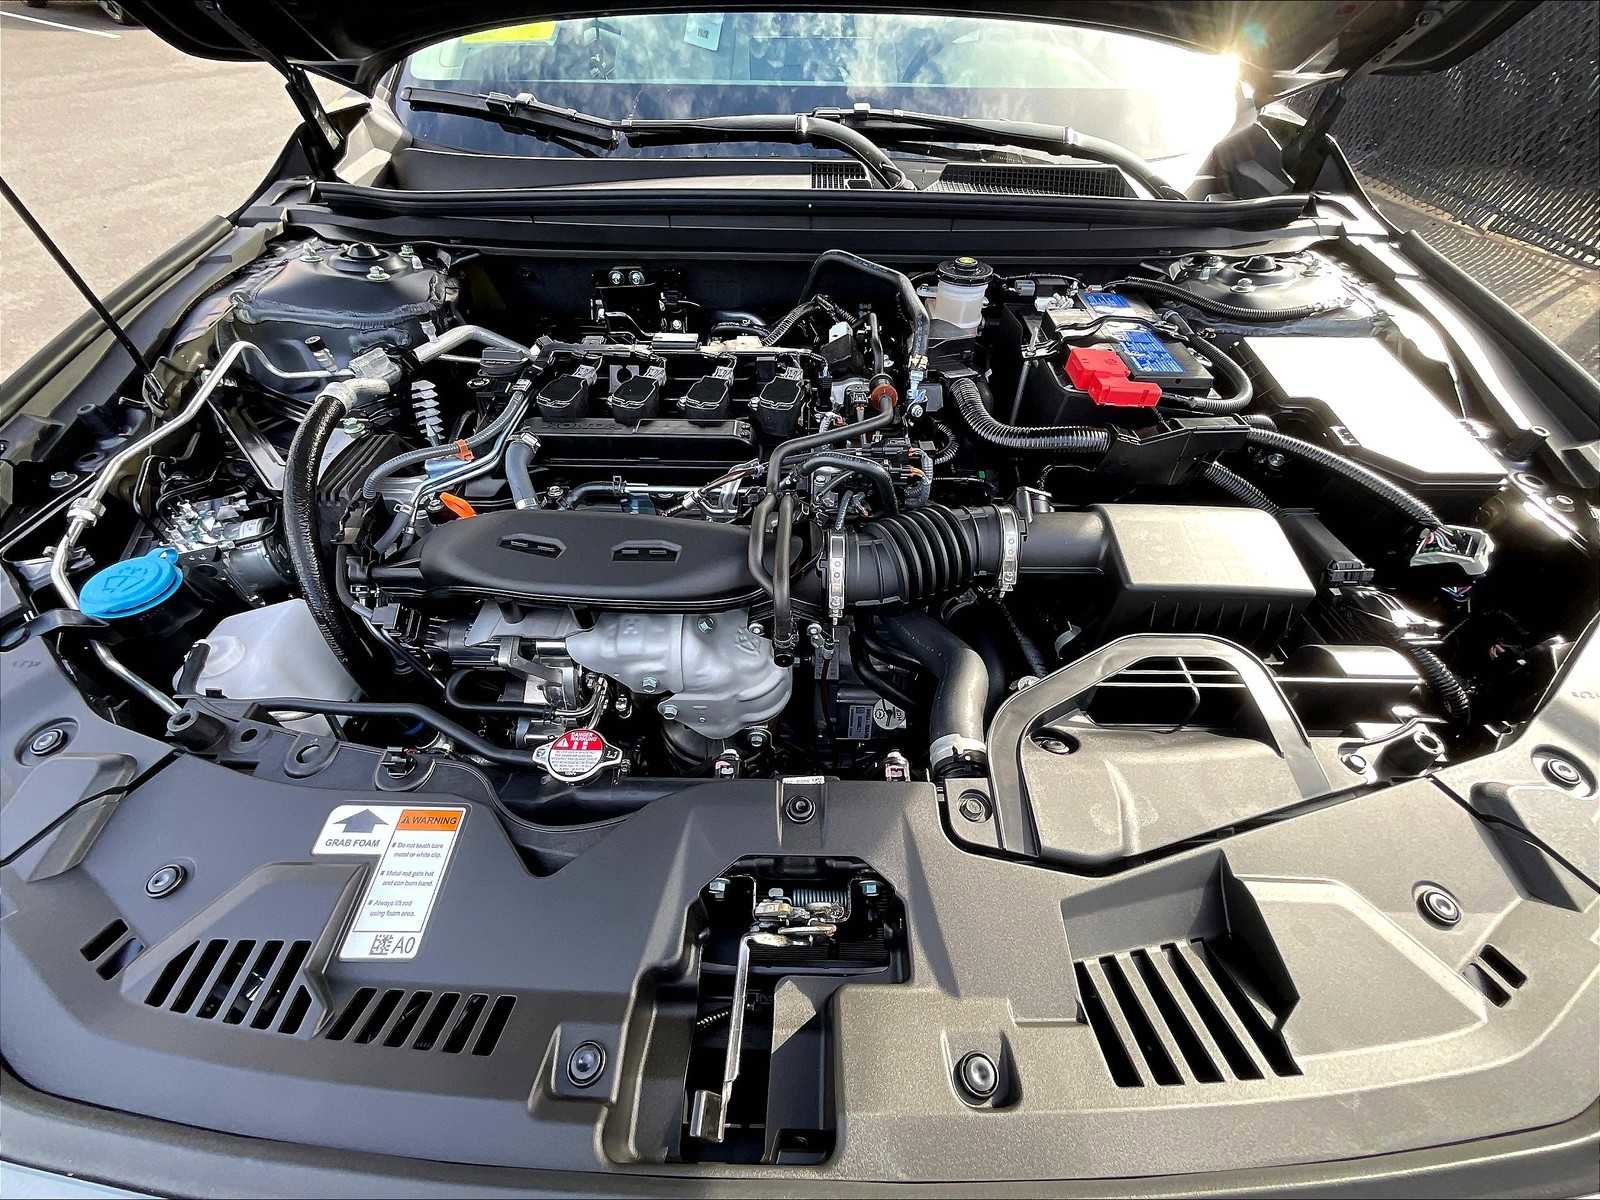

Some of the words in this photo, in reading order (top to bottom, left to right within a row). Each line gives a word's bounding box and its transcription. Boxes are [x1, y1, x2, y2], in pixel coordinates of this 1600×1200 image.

[412, 816, 457, 825] WARNING
[325, 839, 351, 848] GRAB
[352, 839, 381, 848] FOAM
[391, 936, 416, 954] A0
